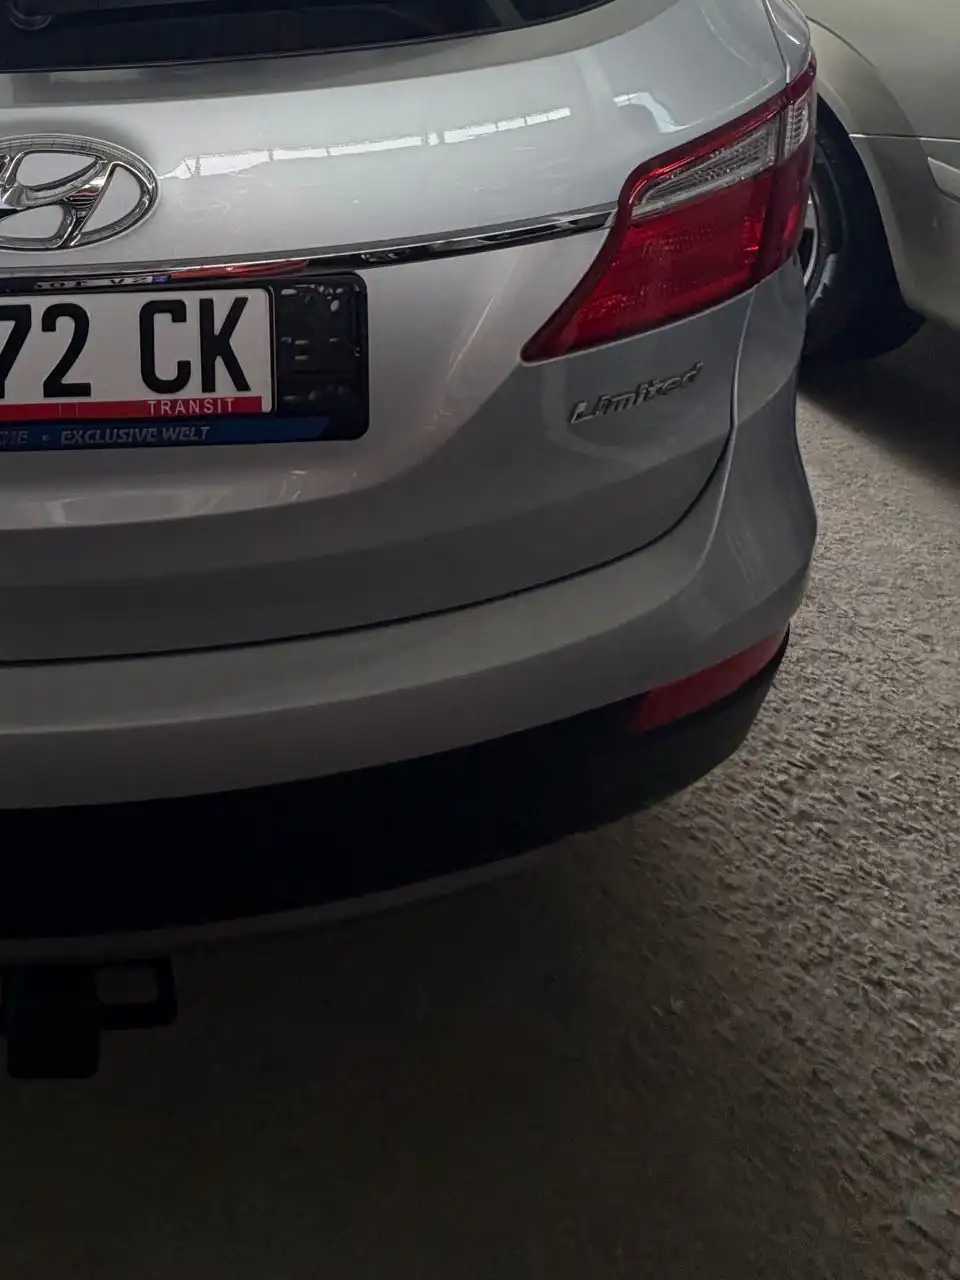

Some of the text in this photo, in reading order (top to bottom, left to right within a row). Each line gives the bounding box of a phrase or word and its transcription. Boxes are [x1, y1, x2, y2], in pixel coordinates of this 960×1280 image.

[139, 296, 252, 394] CK
[147, 397, 235, 416] TRANSIT
[60, 427, 159, 444] EXCLUSIVE
[161, 425, 211, 442] WELT
